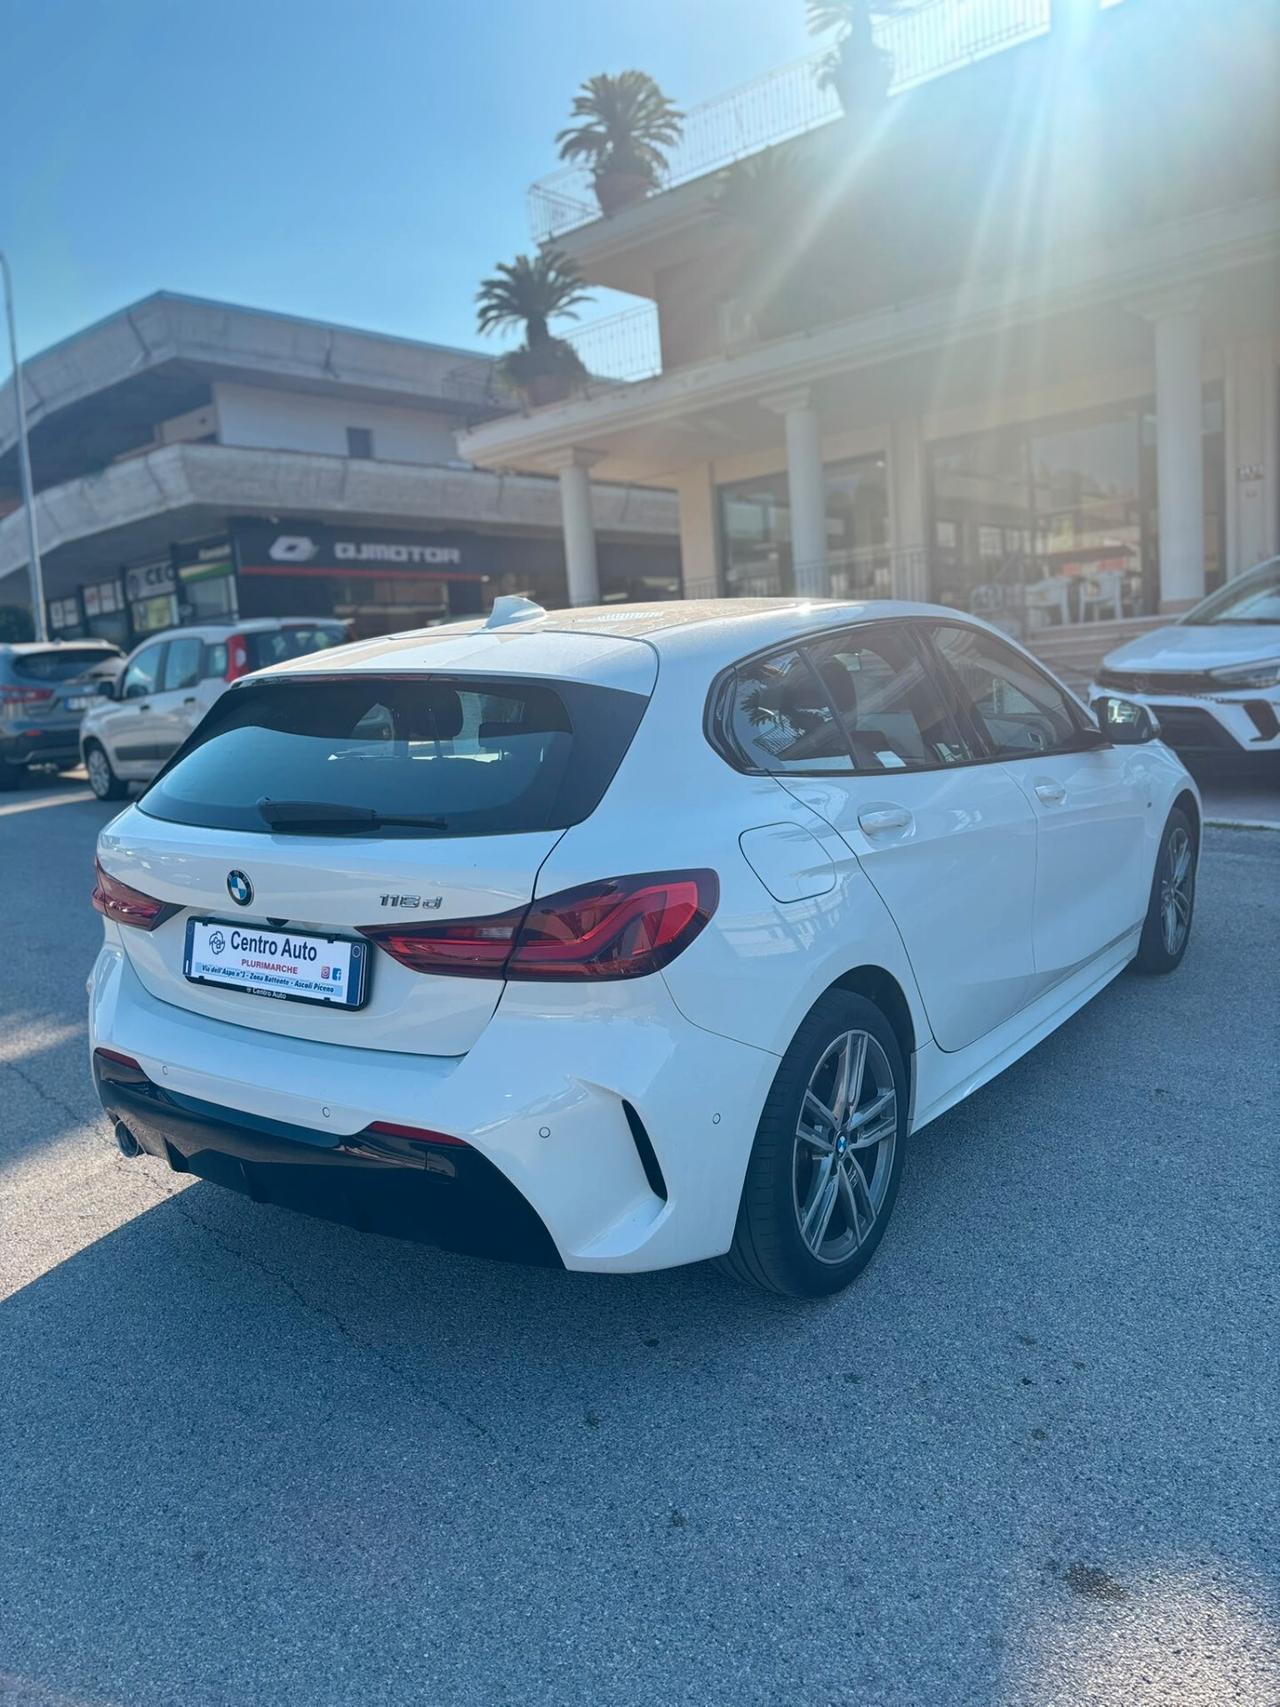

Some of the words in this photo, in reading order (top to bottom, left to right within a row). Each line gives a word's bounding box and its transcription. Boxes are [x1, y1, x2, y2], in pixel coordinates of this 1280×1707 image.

[231, 931, 277, 955] Centro
[281, 938, 317, 961] Auto
[241, 959, 298, 974] PLURIMARCHE
[250, 972, 263, 980] Zona
[294, 980, 312, 989] Ascoli
[313, 982, 334, 993] Piceno
[253, 987, 271, 997] Centro
